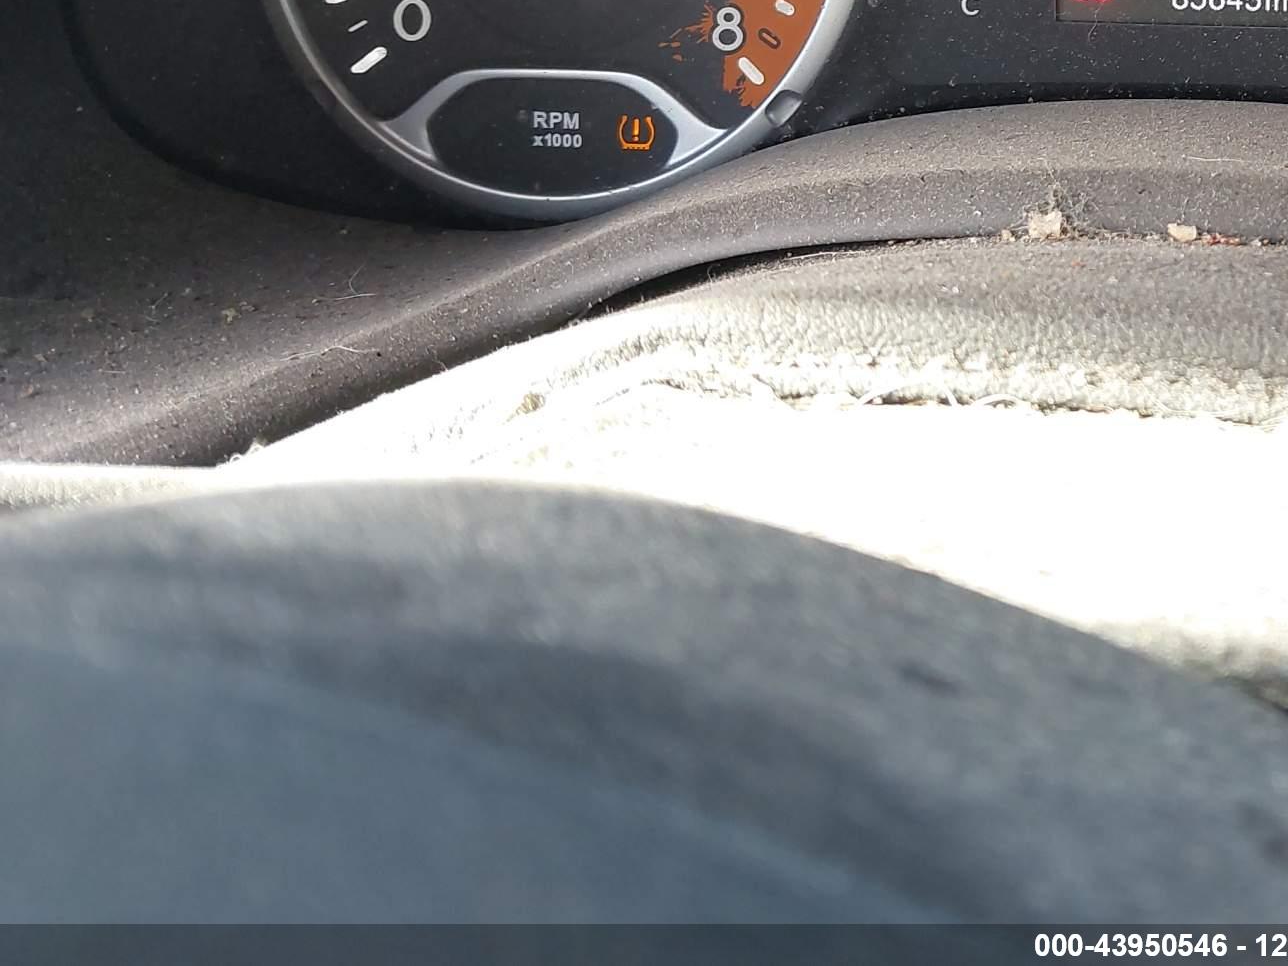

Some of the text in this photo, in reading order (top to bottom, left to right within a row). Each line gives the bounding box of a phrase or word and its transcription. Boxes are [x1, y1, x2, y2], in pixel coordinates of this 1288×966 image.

[712, 6, 745, 52] 8
[533, 111, 580, 130] RPM
[533, 133, 582, 148] x1000
